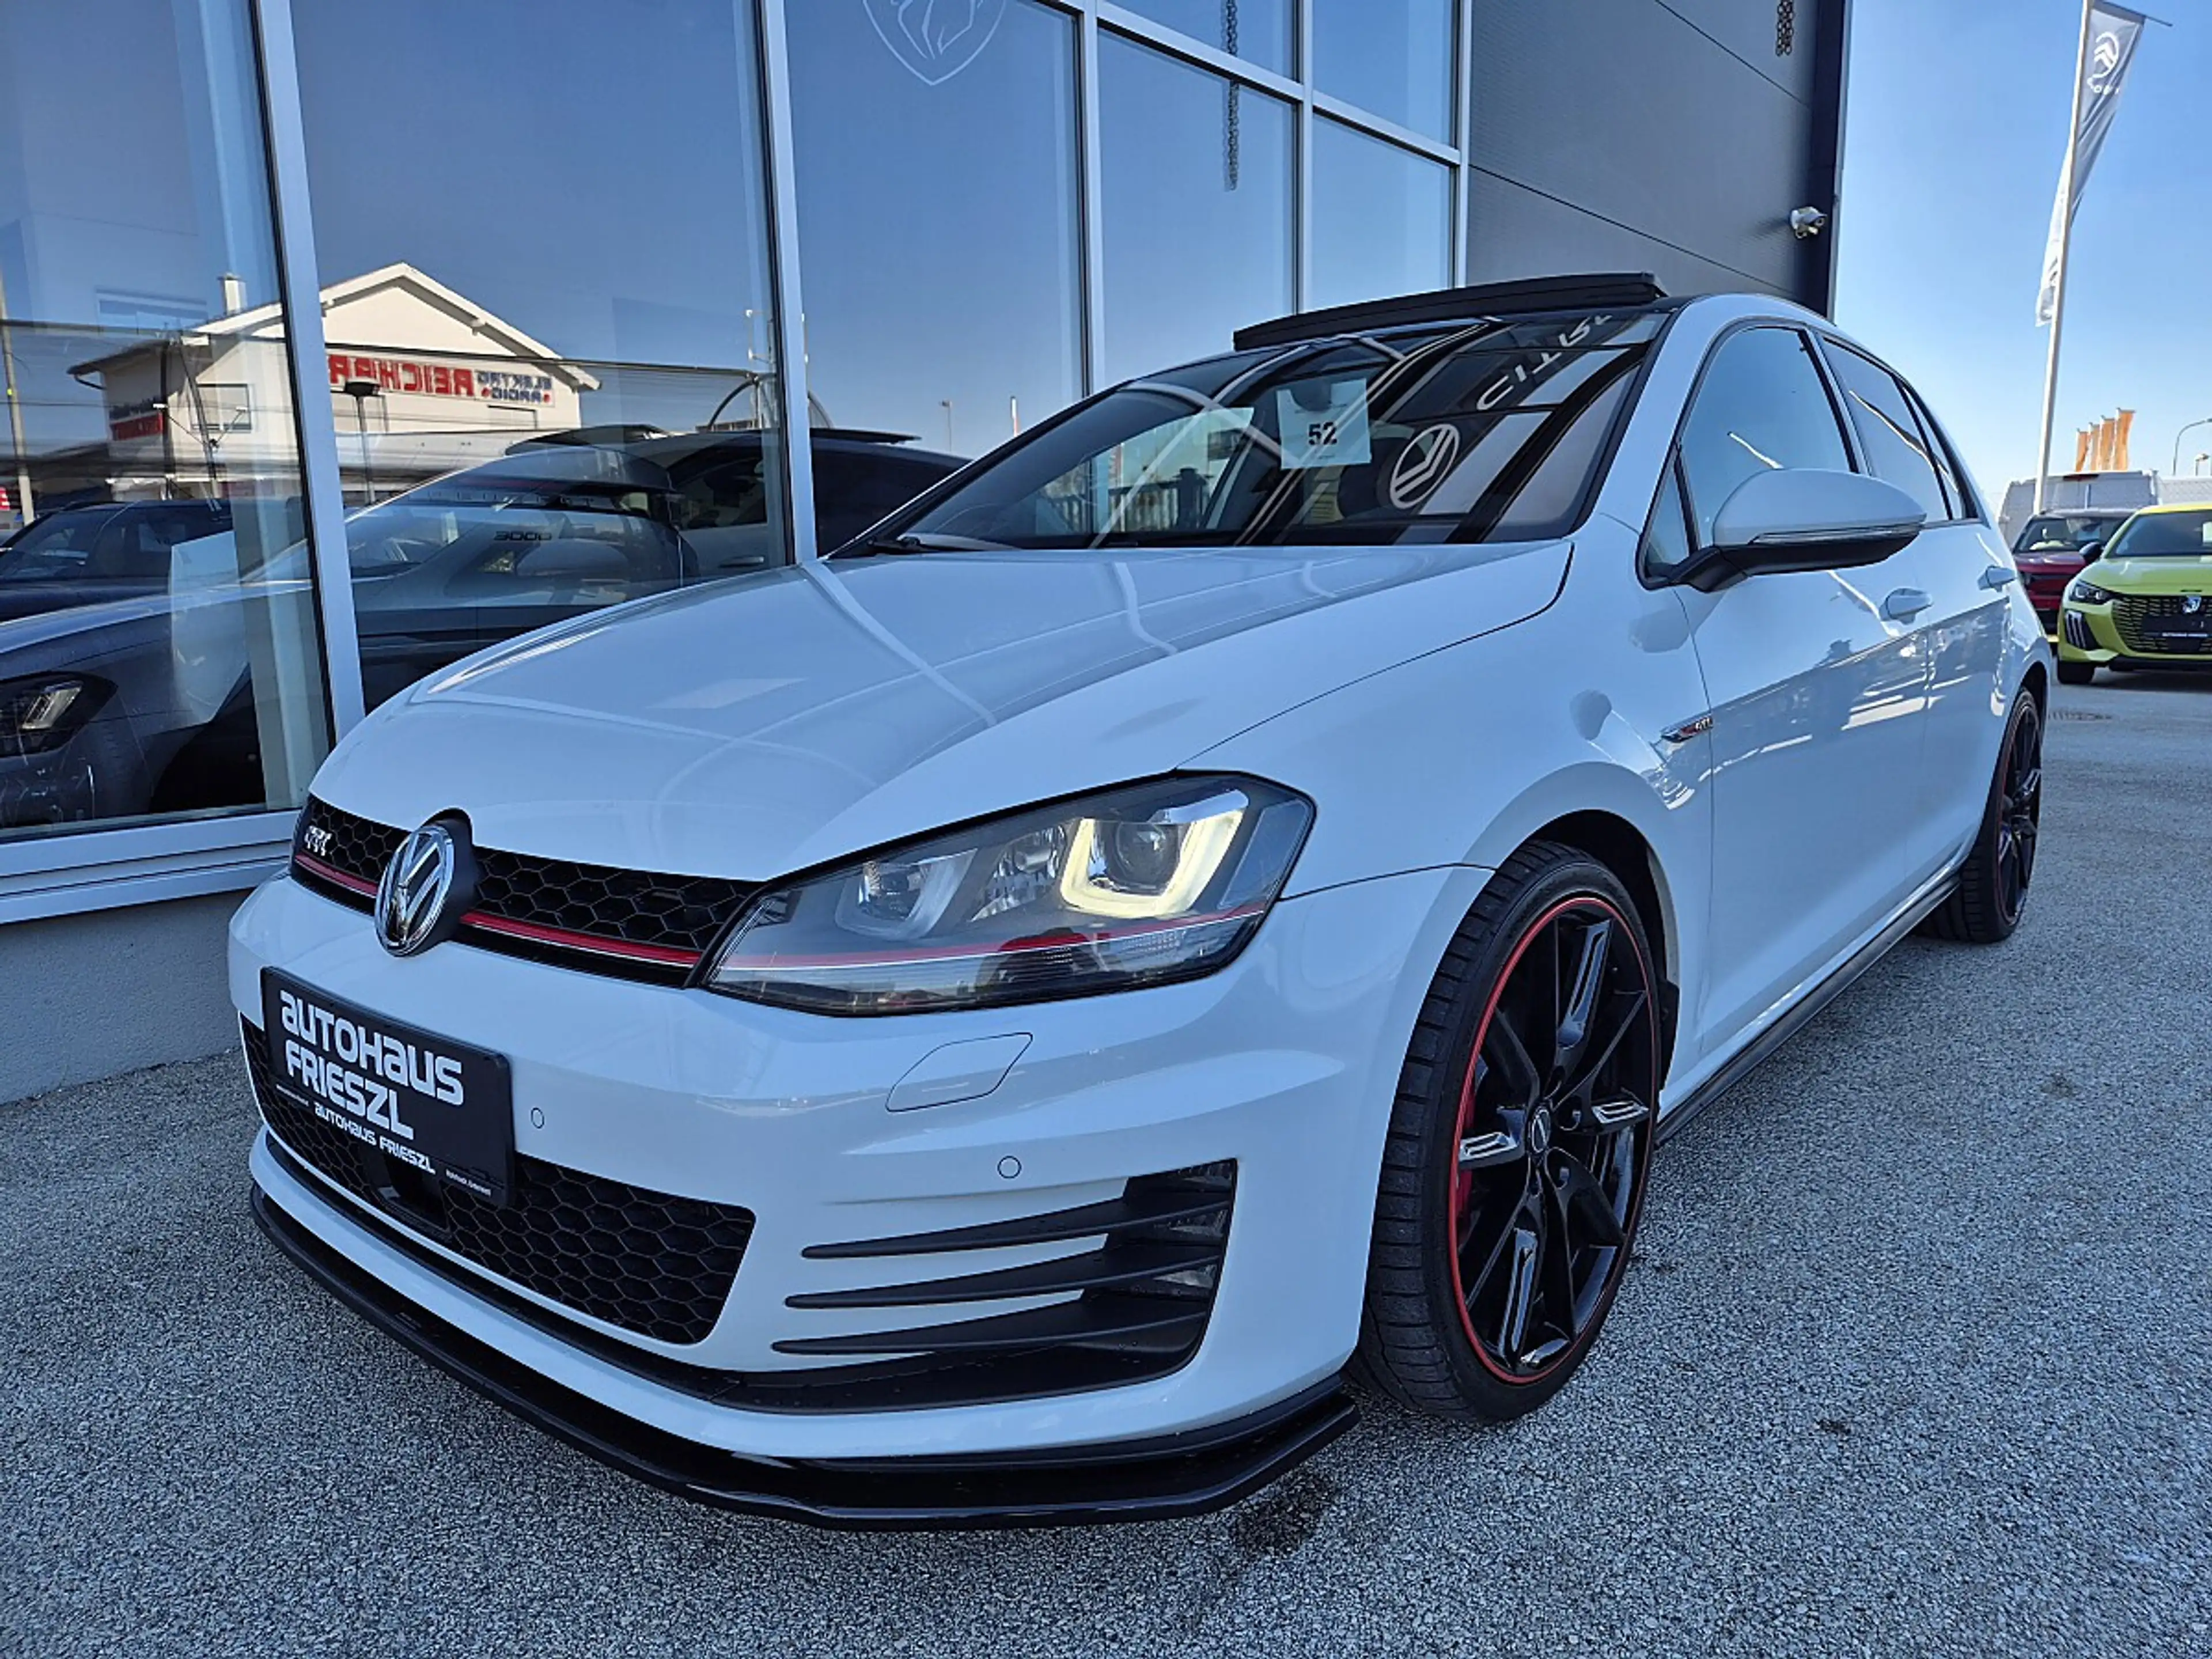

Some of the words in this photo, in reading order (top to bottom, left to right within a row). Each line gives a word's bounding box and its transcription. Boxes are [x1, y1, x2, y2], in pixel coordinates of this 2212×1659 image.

[1308, 421, 1338, 445] 52
[285, 1039, 414, 1141] FRIESZL
[379, 1135, 436, 1175] FRIESZL
